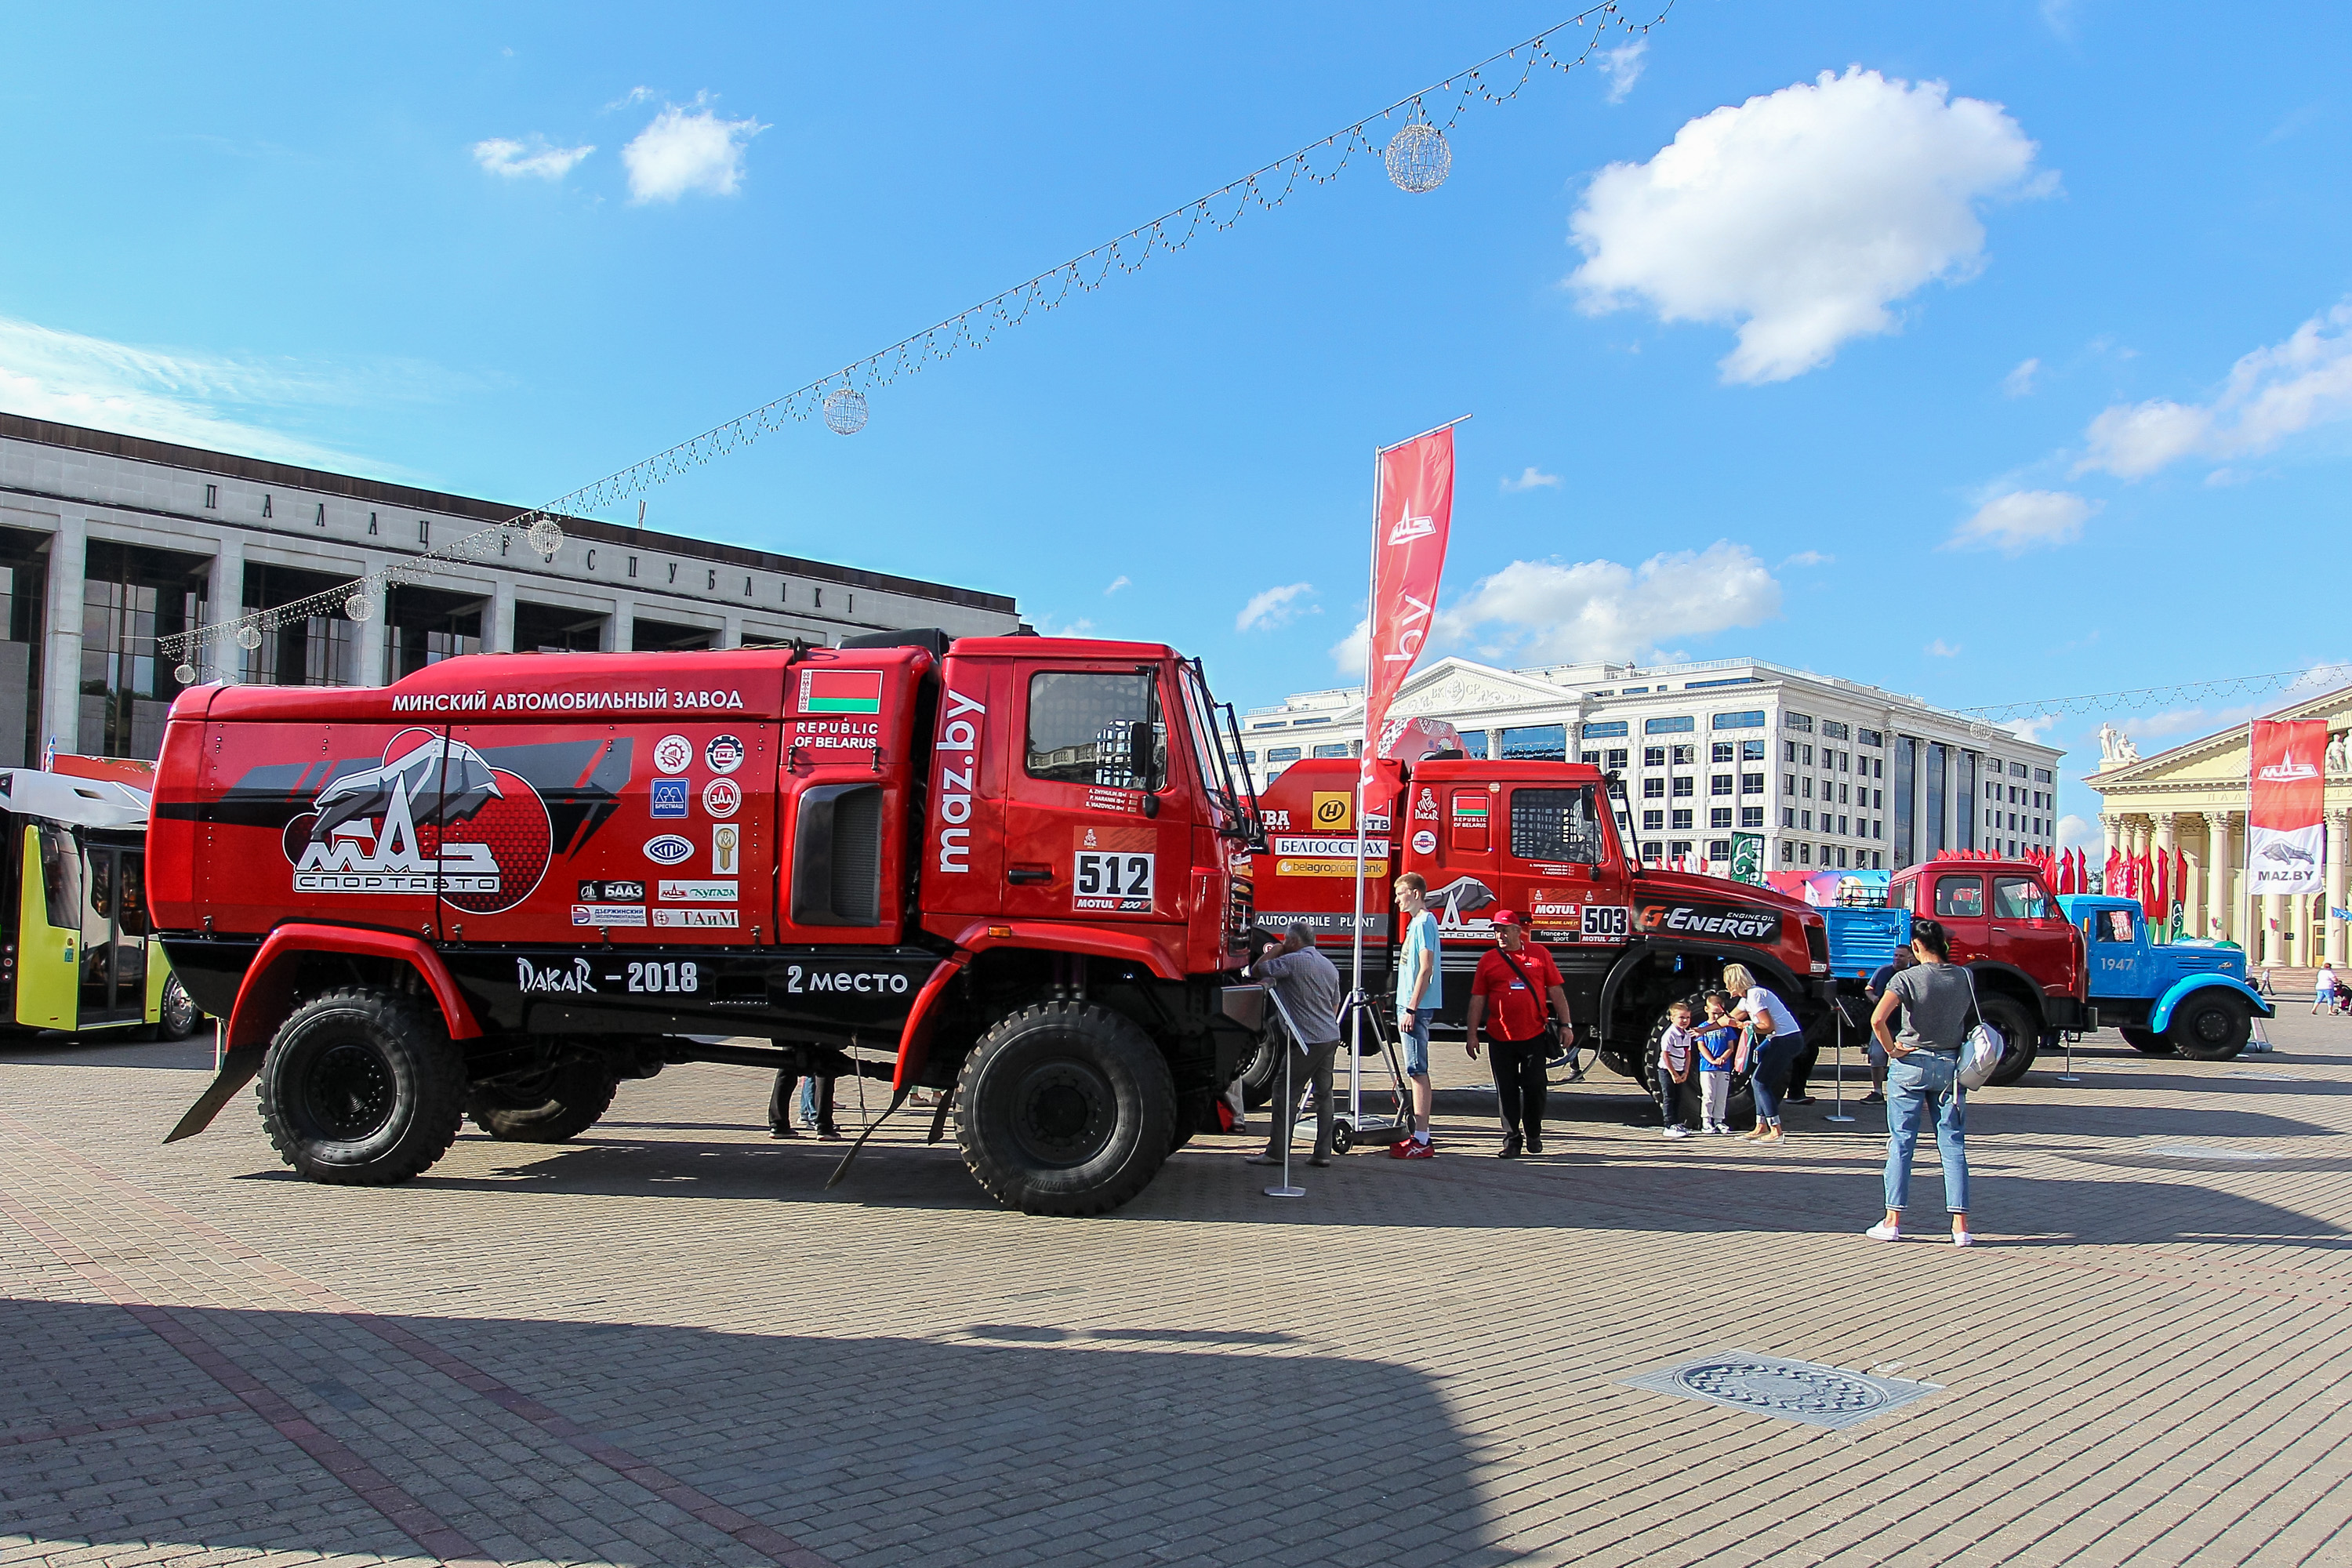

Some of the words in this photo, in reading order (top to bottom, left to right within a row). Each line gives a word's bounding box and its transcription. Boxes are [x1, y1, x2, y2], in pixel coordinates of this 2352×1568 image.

[205, 484, 430, 549] ПАЛАЦ
[392, 690, 487, 711] МИНСКИЙ
[492, 688, 667, 710] АВТОМОБИЛЬНЫЙ
[673, 690, 744, 710] ЗАВОД
[796, 722, 879, 735] REPUBLIC
[794, 736, 812, 748] OF
[815, 736, 877, 749] BELARUS
[936, 688, 986, 873] maz.by
[2207, 793, 2242, 802] ПАЛ
[1414, 808, 1439, 821] DAKAR
[1281, 840, 1383, 855] БЕЛГОССТАХ
[1293, 861, 1382, 873] belagropromank
[1079, 855, 1149, 895] 512
[2258, 870, 2314, 881] MAZ.BY
[299, 877, 496, 890] СПОРТАВТО
[604, 884, 643, 898] БААЗ
[1076, 898, 1115, 909] MOTUL
[1120, 900, 1151, 909] 300V
[1534, 905, 1577, 915] MOTUL
[680, 911, 738, 926] ТАиМ
[1257, 915, 1330, 927] AUTOMOBILE
[1340, 916, 1375, 927] PLANT
[1584, 908, 1627, 934] 503
[1726, 911, 1761, 921] ENGINE
[2100, 957, 2134, 971] 1947
[628, 962, 698, 993] 2018
[788, 965, 803, 993] 2
[809, 971, 909, 994] место
